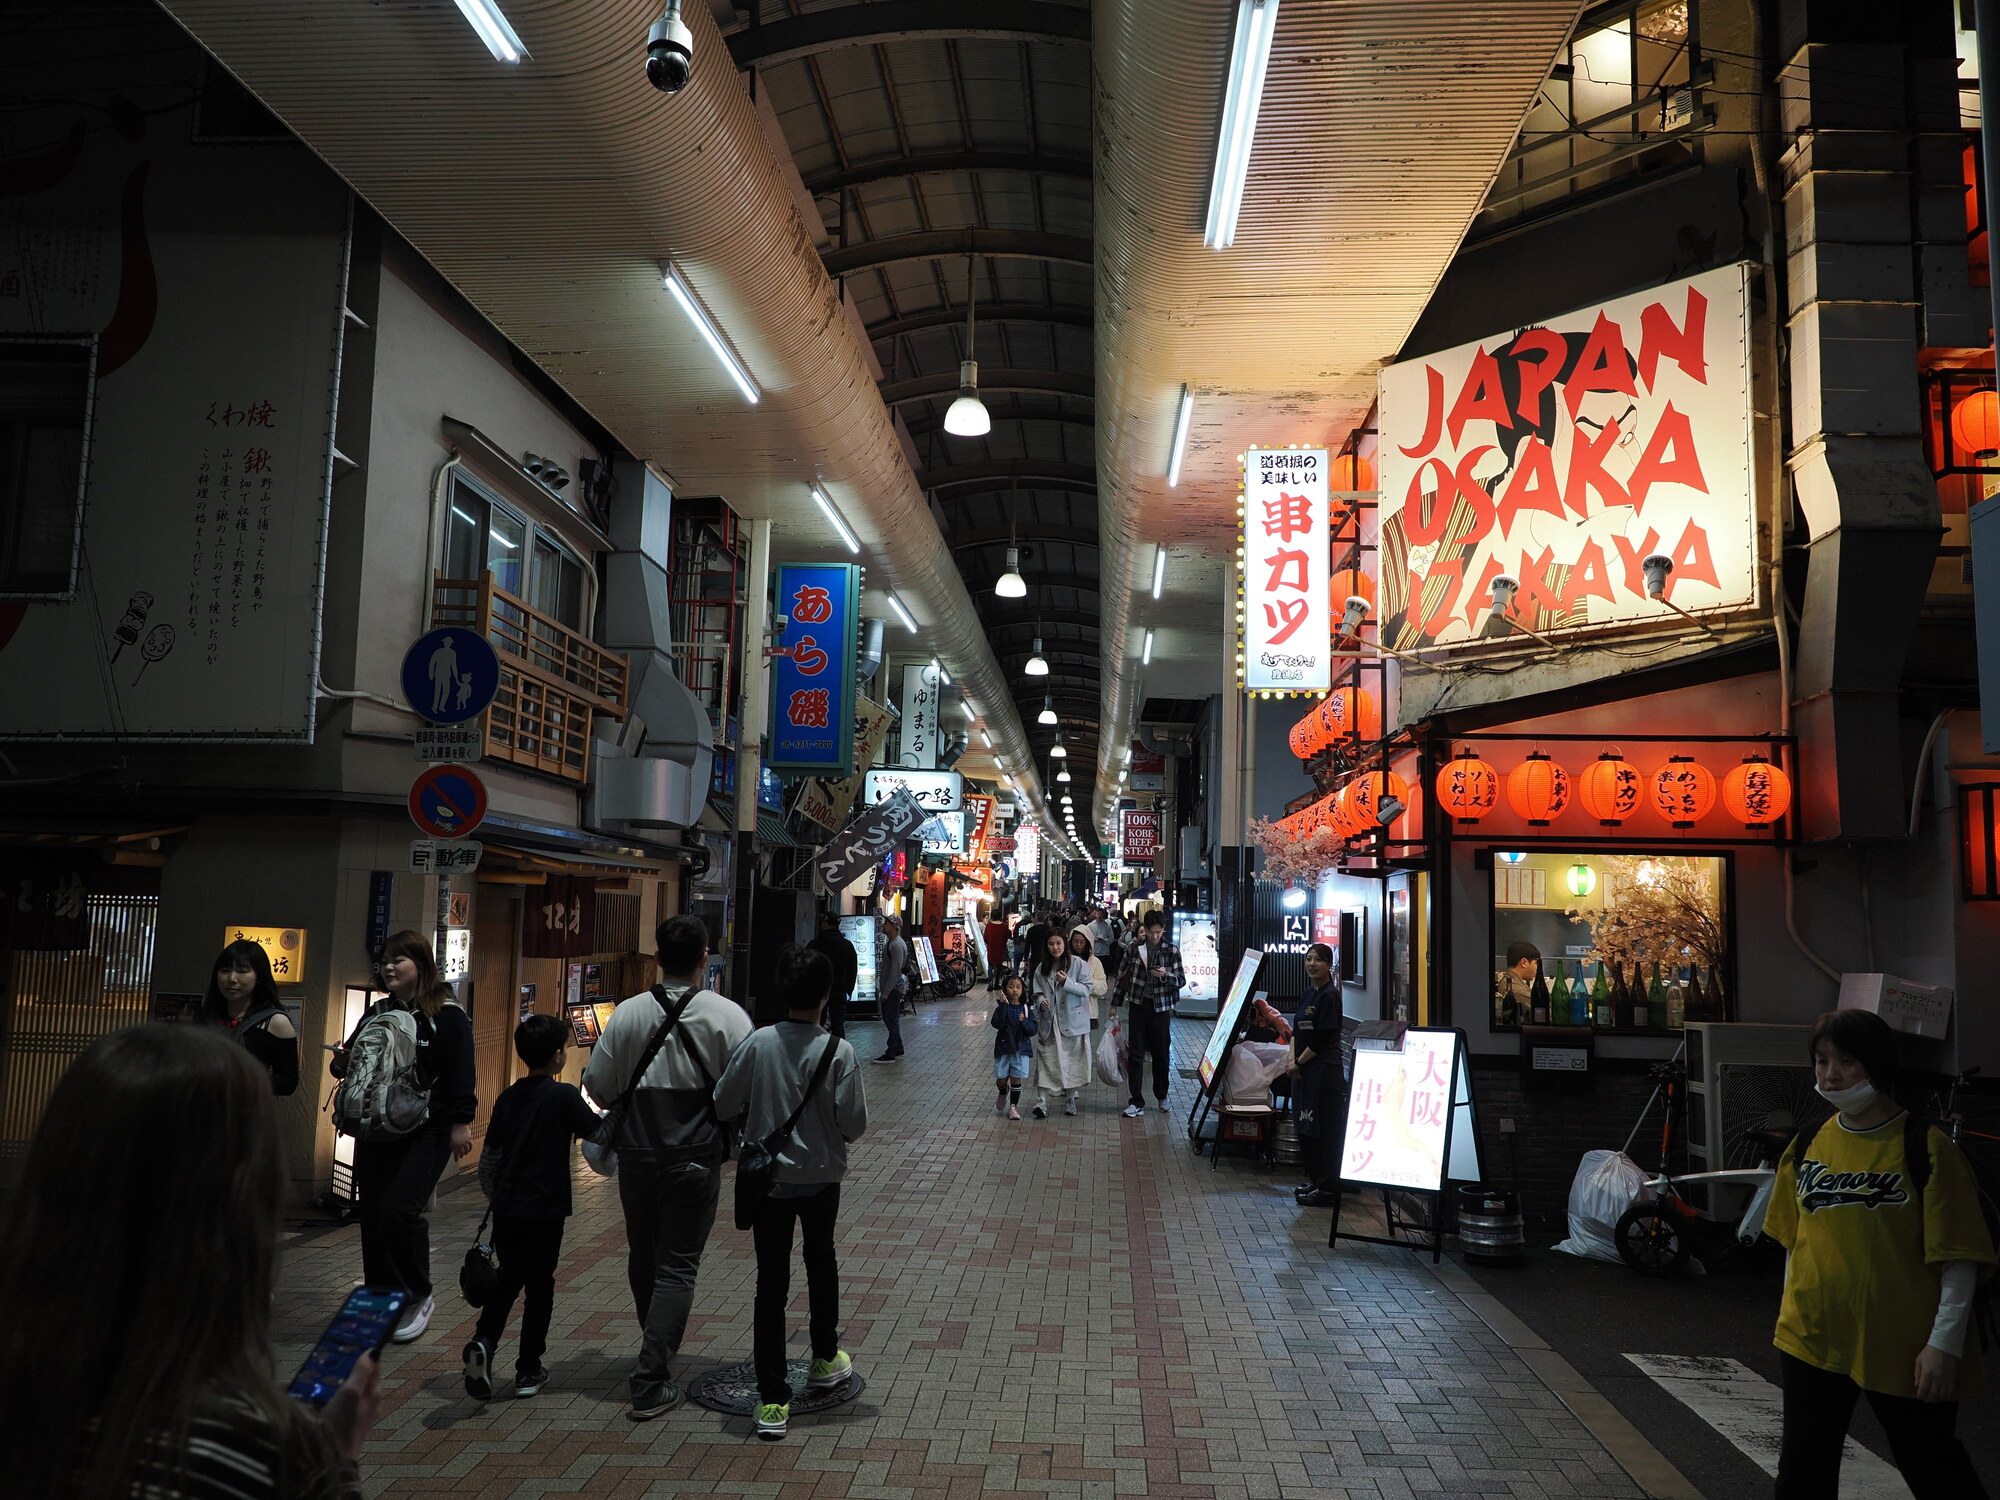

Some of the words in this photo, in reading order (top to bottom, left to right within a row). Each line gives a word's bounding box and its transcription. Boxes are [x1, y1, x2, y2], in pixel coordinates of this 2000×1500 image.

[1397, 284, 1710, 459] JAPAN
[206, 400, 277, 428] くわ焼
[1260, 454, 1317, 469] 道頓堀の
[1260, 471, 1317, 485] 美味しい
[1404, 398, 1710, 547] OSAKA
[1261, 491, 1314, 646] 串カツ
[1407, 516, 1722, 638] IZAKAYA
[787, 584, 833, 728] あら磯
[912, 688, 928, 752] ゆまる
[421, 746, 472, 759] 出入庫車を除く
[876, 787, 954, 806] の路
[1451, 770, 1467, 807] やねん
[1468, 770, 1483, 807] ソース
[1547, 767, 1568, 812] お刺身
[1615, 770, 1637, 814] 串カツ
[1677, 771, 1697, 814] めっちゃ
[1745, 771, 1771, 818] お好み焼き
[803, 796, 837, 829] 3,000円
[1126, 815, 1158, 826] 100%
[1128, 828, 1155, 838] KOBE
[412, 849, 478, 867] 自動車
[819, 802, 915, 885] 肉うどん
[1129, 838, 1153, 847] BEEF
[1263, 943, 1288, 954] IAM
[1290, 943, 1313, 955] HO
[1409, 1050, 1449, 1128] 大阪
[1351, 1078, 1383, 1175] 串カツ
[1797, 1159, 1905, 1200] Memory
